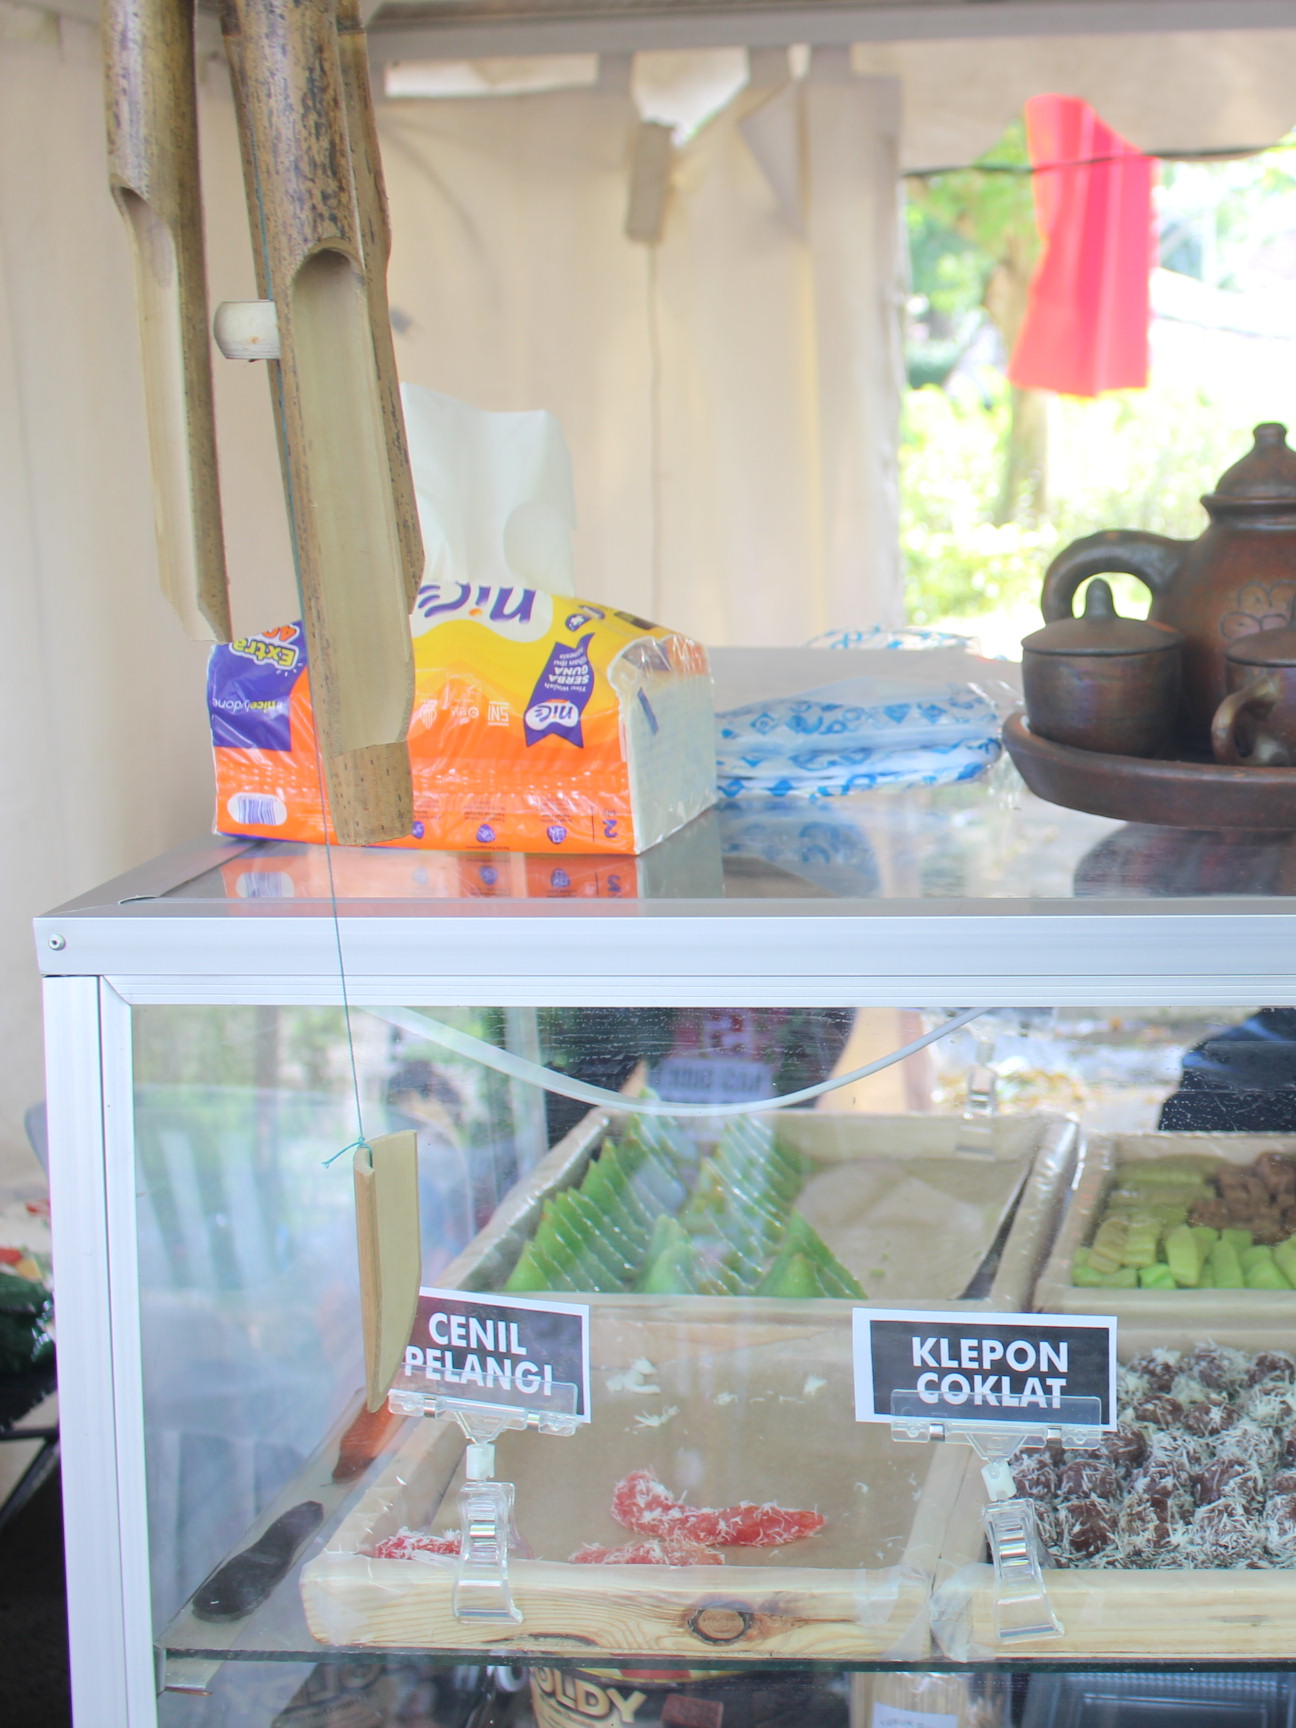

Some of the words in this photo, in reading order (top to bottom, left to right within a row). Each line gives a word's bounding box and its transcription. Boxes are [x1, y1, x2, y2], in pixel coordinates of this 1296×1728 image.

[232, 638, 296, 667] Extra
[548, 673, 589, 685] SERBA
[554, 664, 589, 675] GUNA
[487, 704, 509, 723] SNI
[602, 819, 618, 838] 2
[428, 1312, 527, 1356] CENIL
[911, 1336, 1069, 1373] KLEPON
[404, 1345, 553, 1396] PELANGI
[916, 1371, 1067, 1409] COKLAT
